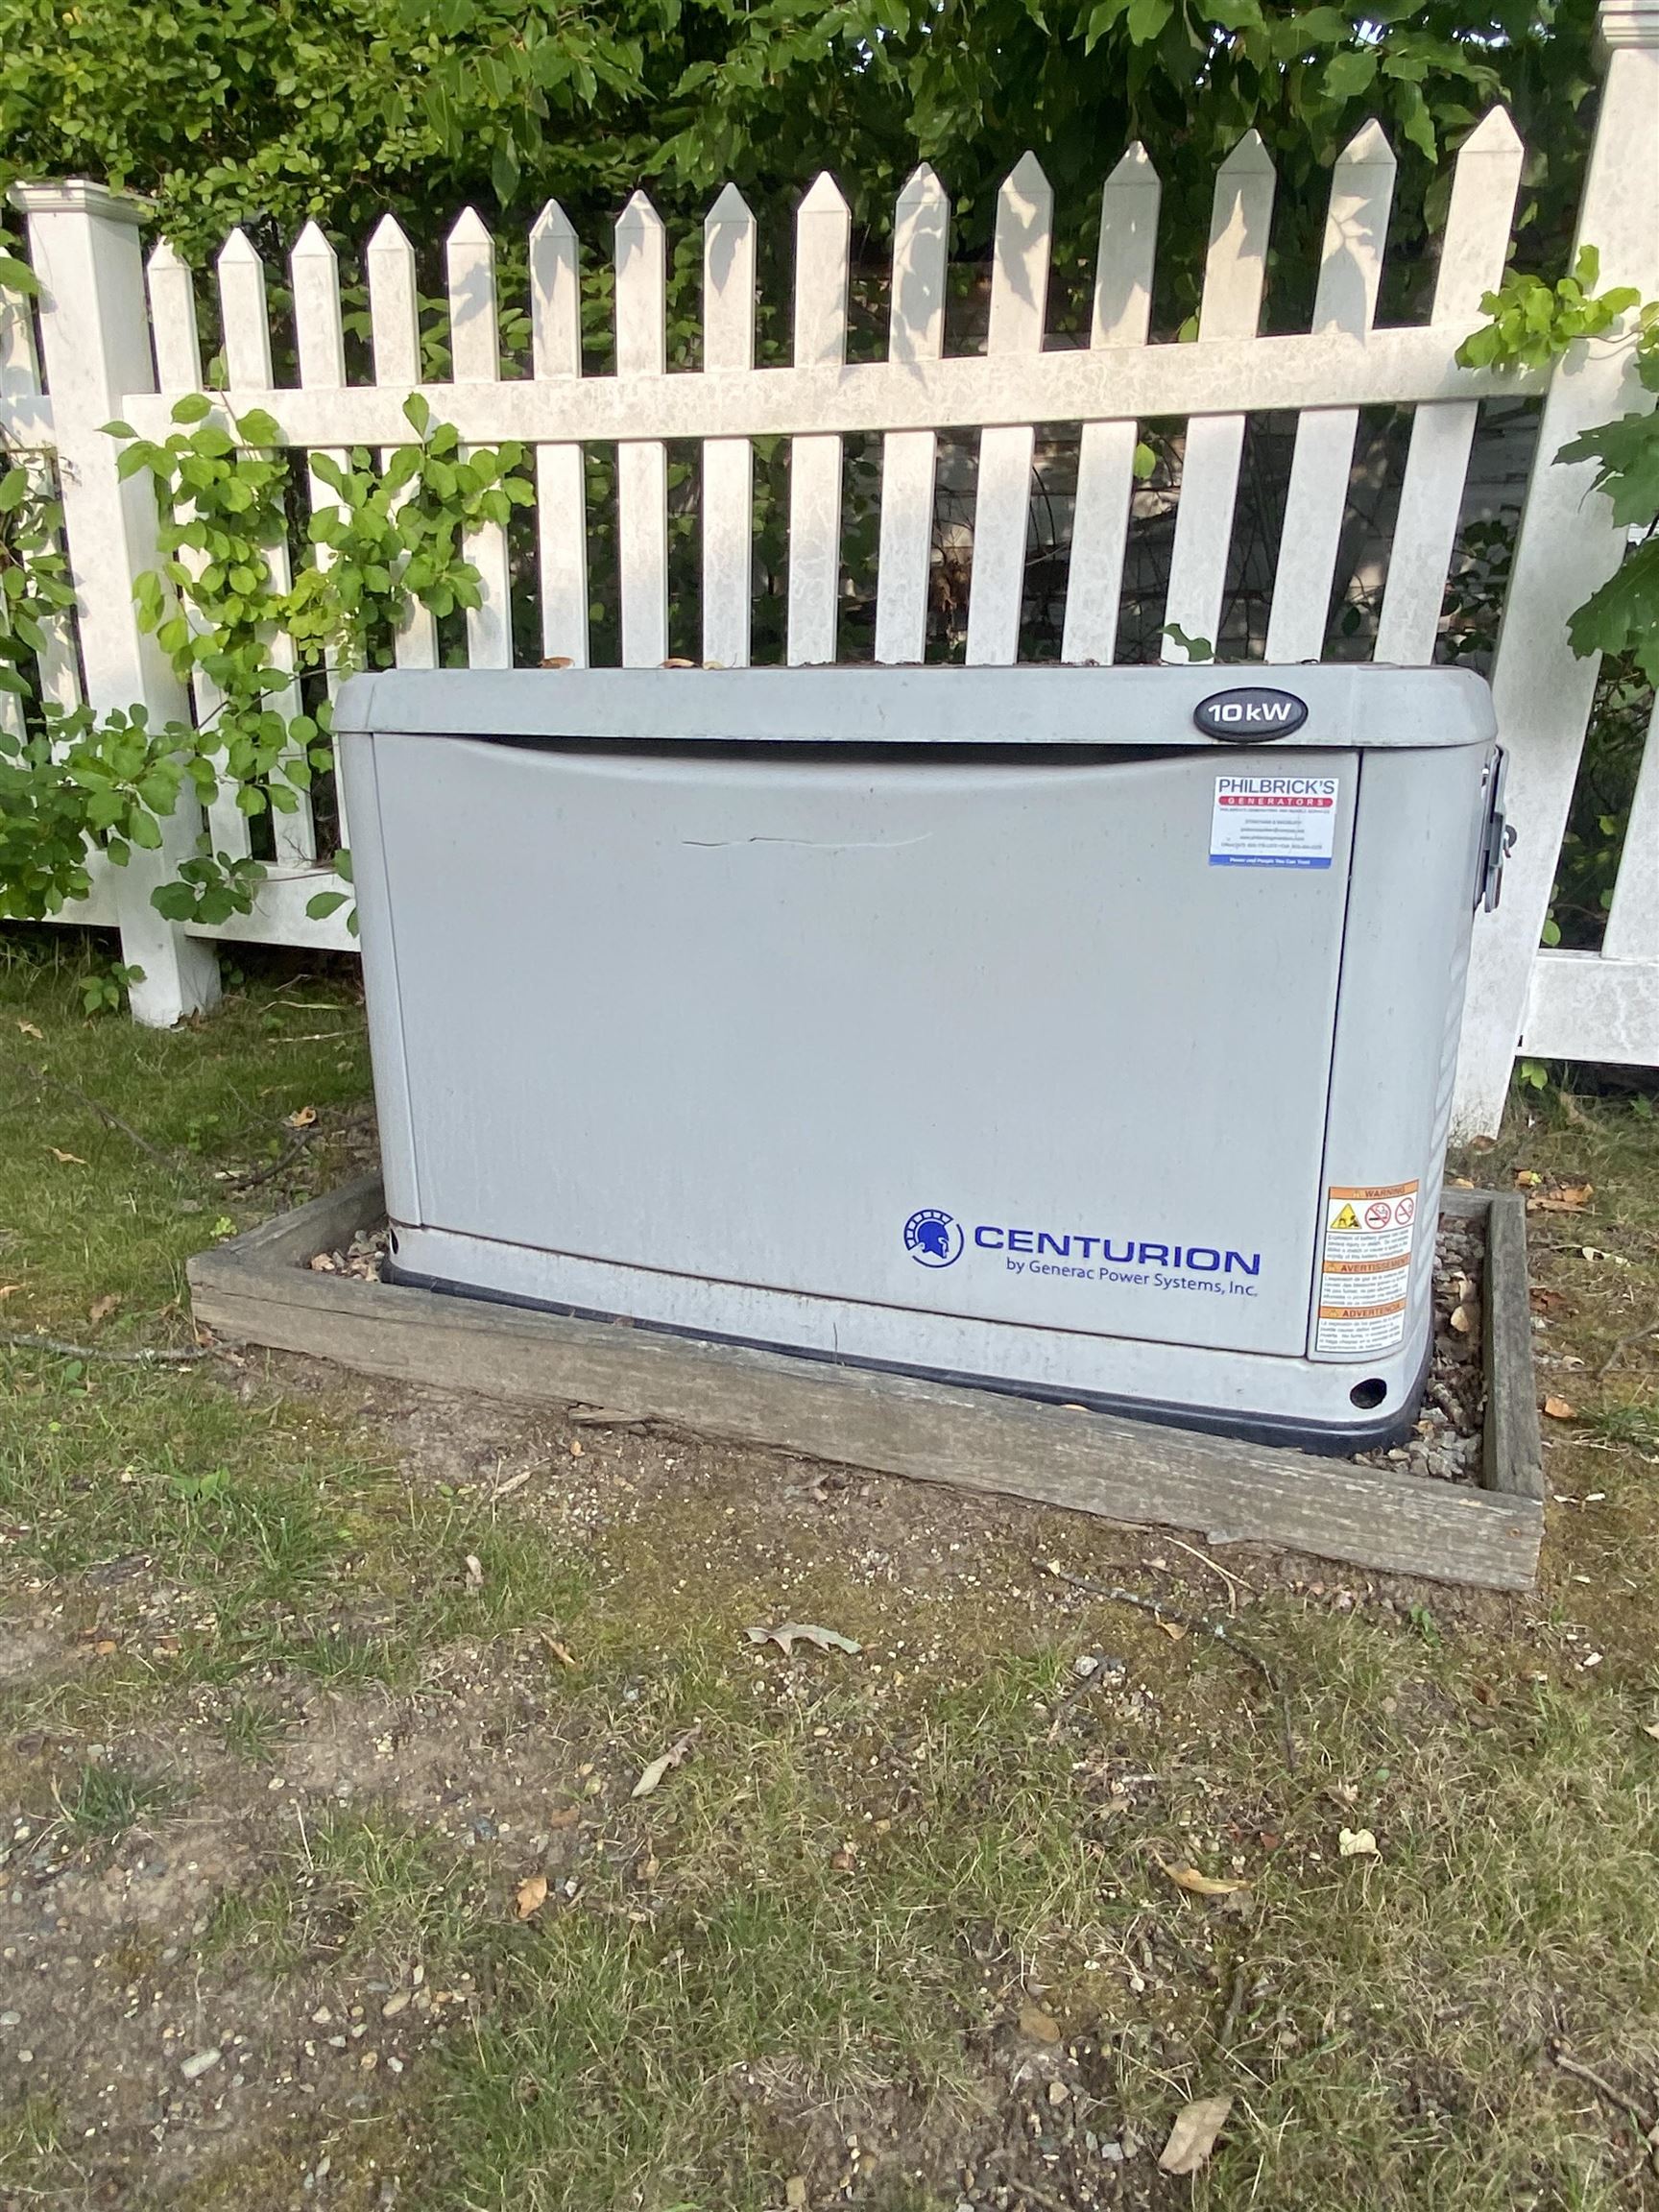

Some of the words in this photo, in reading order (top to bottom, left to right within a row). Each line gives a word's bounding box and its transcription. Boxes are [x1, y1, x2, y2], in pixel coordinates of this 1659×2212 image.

[1218, 779, 1335, 795] PHILBRICK'S
[1228, 797, 1324, 806] GENERATORS
[1364, 1186, 1406, 1197] WARNING
[974, 1225, 1261, 1276] CENTURION
[1006, 1257, 1024, 1275] by
[1029, 1260, 1094, 1279] Generac
[1099, 1267, 1150, 1285] Power
[1154, 1272, 1225, 1296] Systems,
[1229, 1281, 1259, 1297] Inc.
